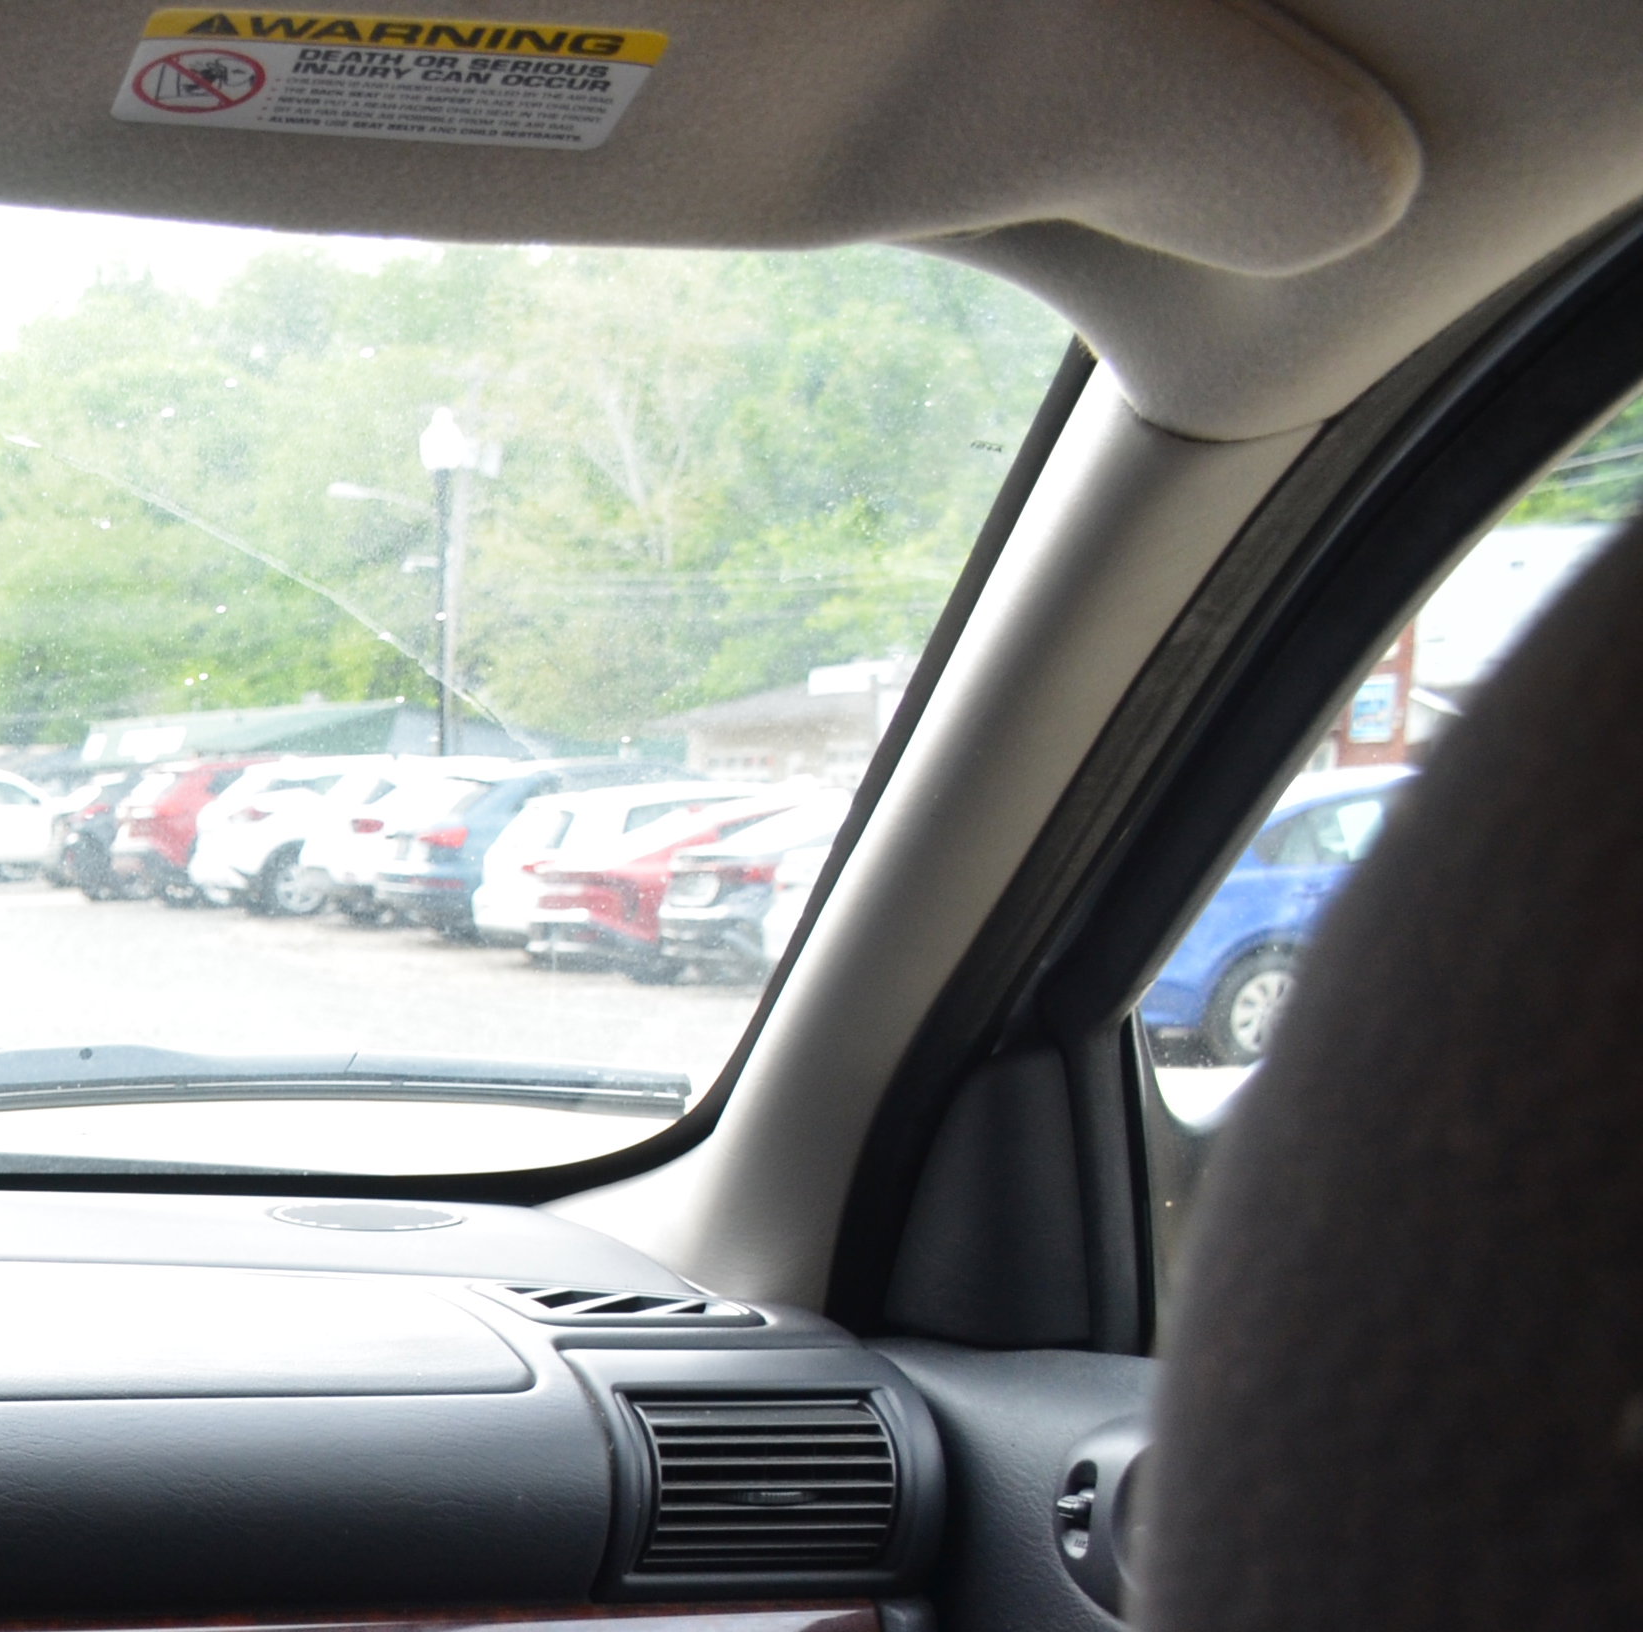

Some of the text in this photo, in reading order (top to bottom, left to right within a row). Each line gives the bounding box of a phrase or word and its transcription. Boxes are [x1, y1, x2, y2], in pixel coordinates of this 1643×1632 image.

[248, 15, 626, 56] WARNING
[292, 63, 413, 81] INJURY
[421, 69, 490, 87] CAN
[499, 74, 611, 93] OCCUR
[299, 48, 609, 79] DEATH OR SERIOUS
